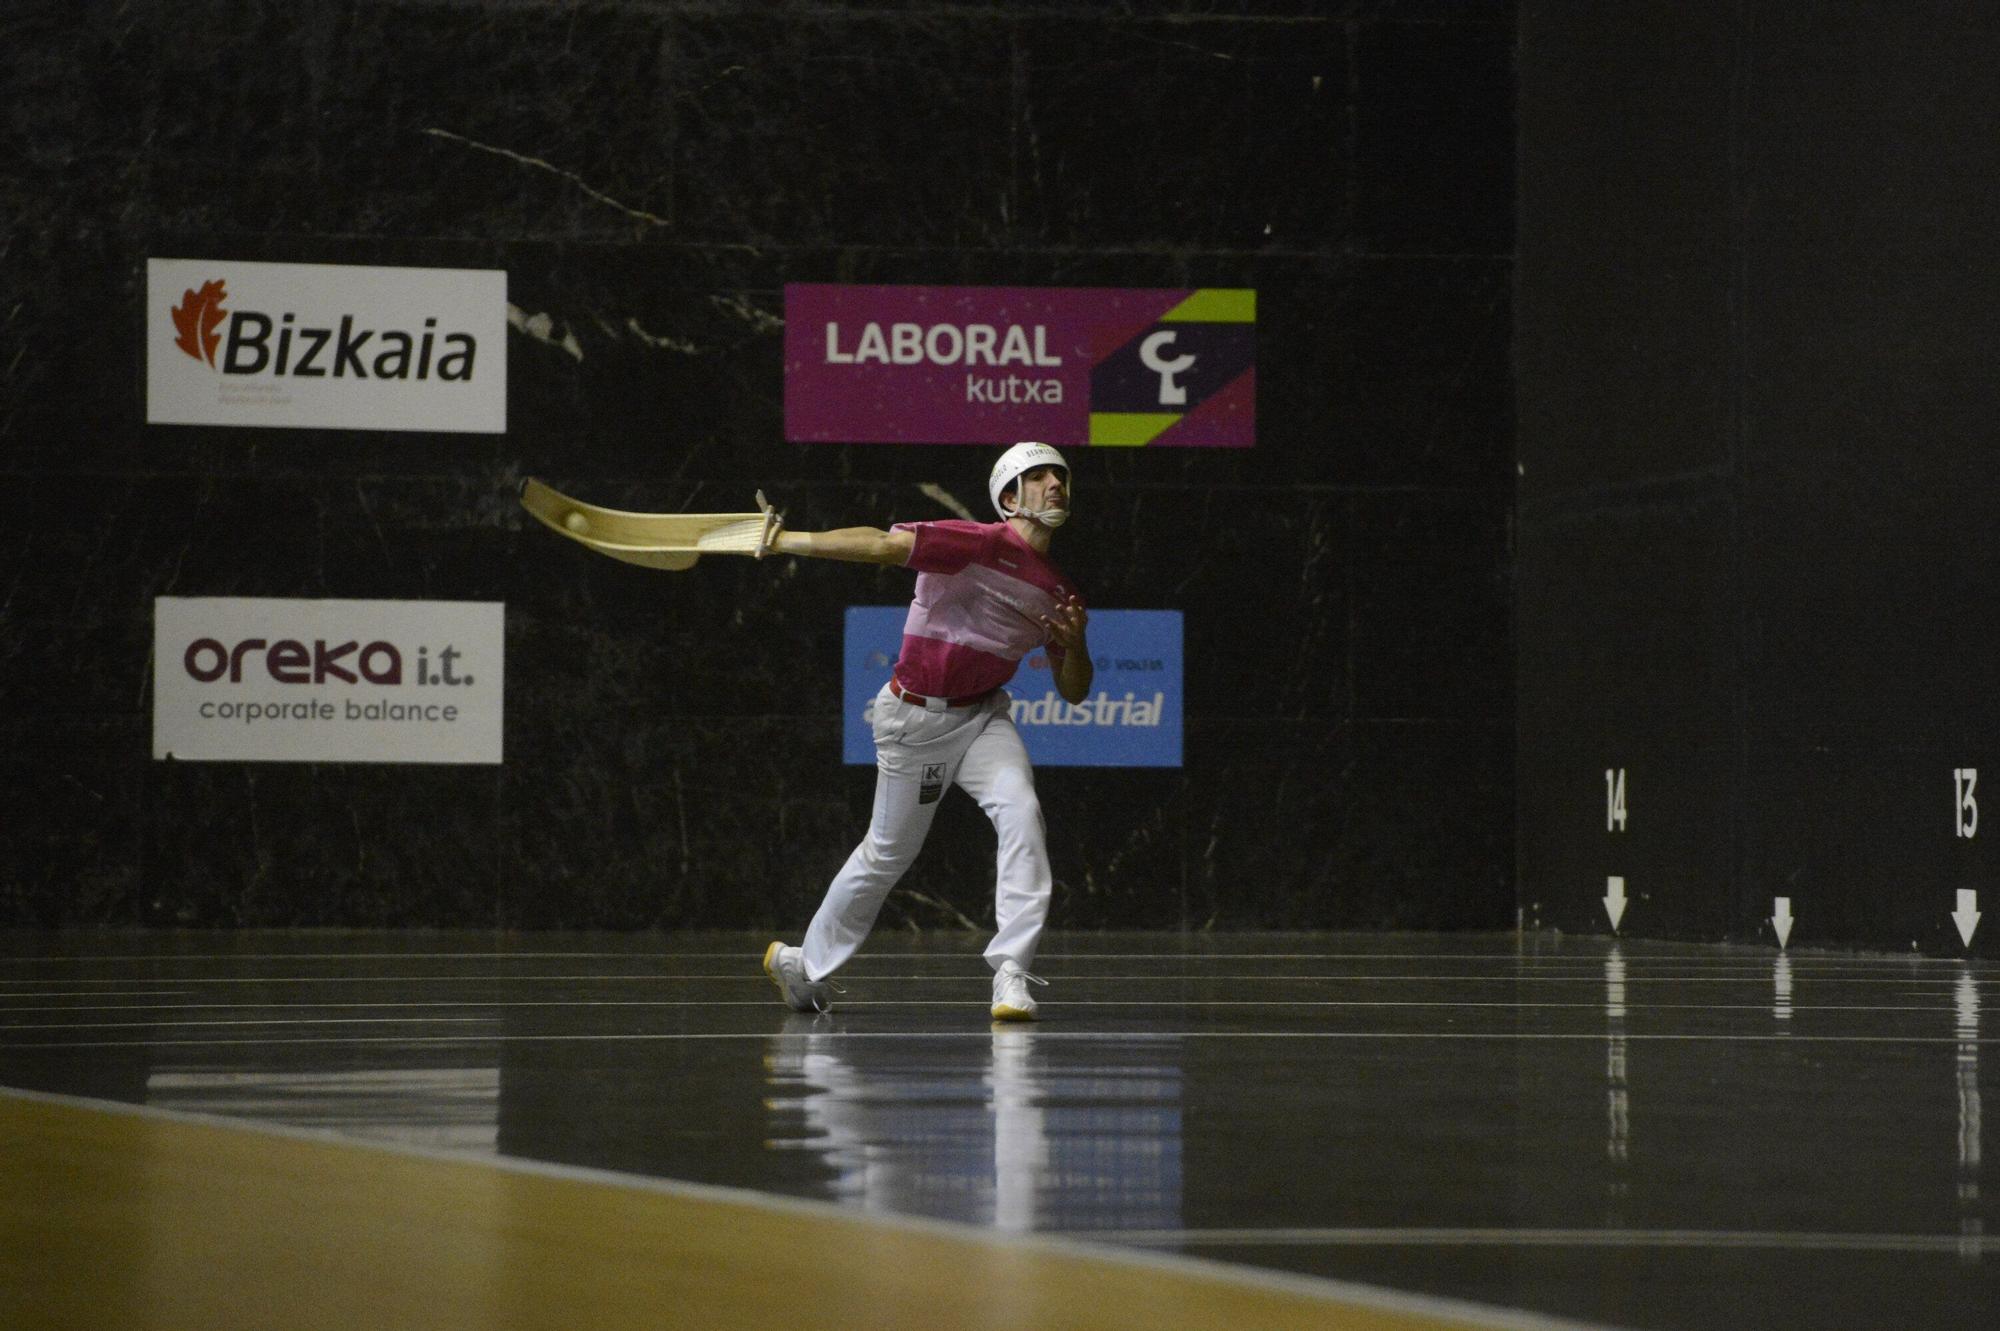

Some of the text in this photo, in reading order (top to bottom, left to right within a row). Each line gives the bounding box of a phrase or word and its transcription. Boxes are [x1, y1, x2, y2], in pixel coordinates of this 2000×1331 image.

[223, 310, 477, 381] Bizkaia
[825, 322, 1062, 366] LABORAL
[966, 374, 1063, 404] kutxa
[184, 637, 475, 686] oreka i.t.
[198, 698, 458, 723] corporate balance
[1009, 691, 1164, 727] ndustrial
[925, 765, 941, 780] K
[1605, 768, 1627, 832] 14
[1953, 768, 1978, 838] 13
